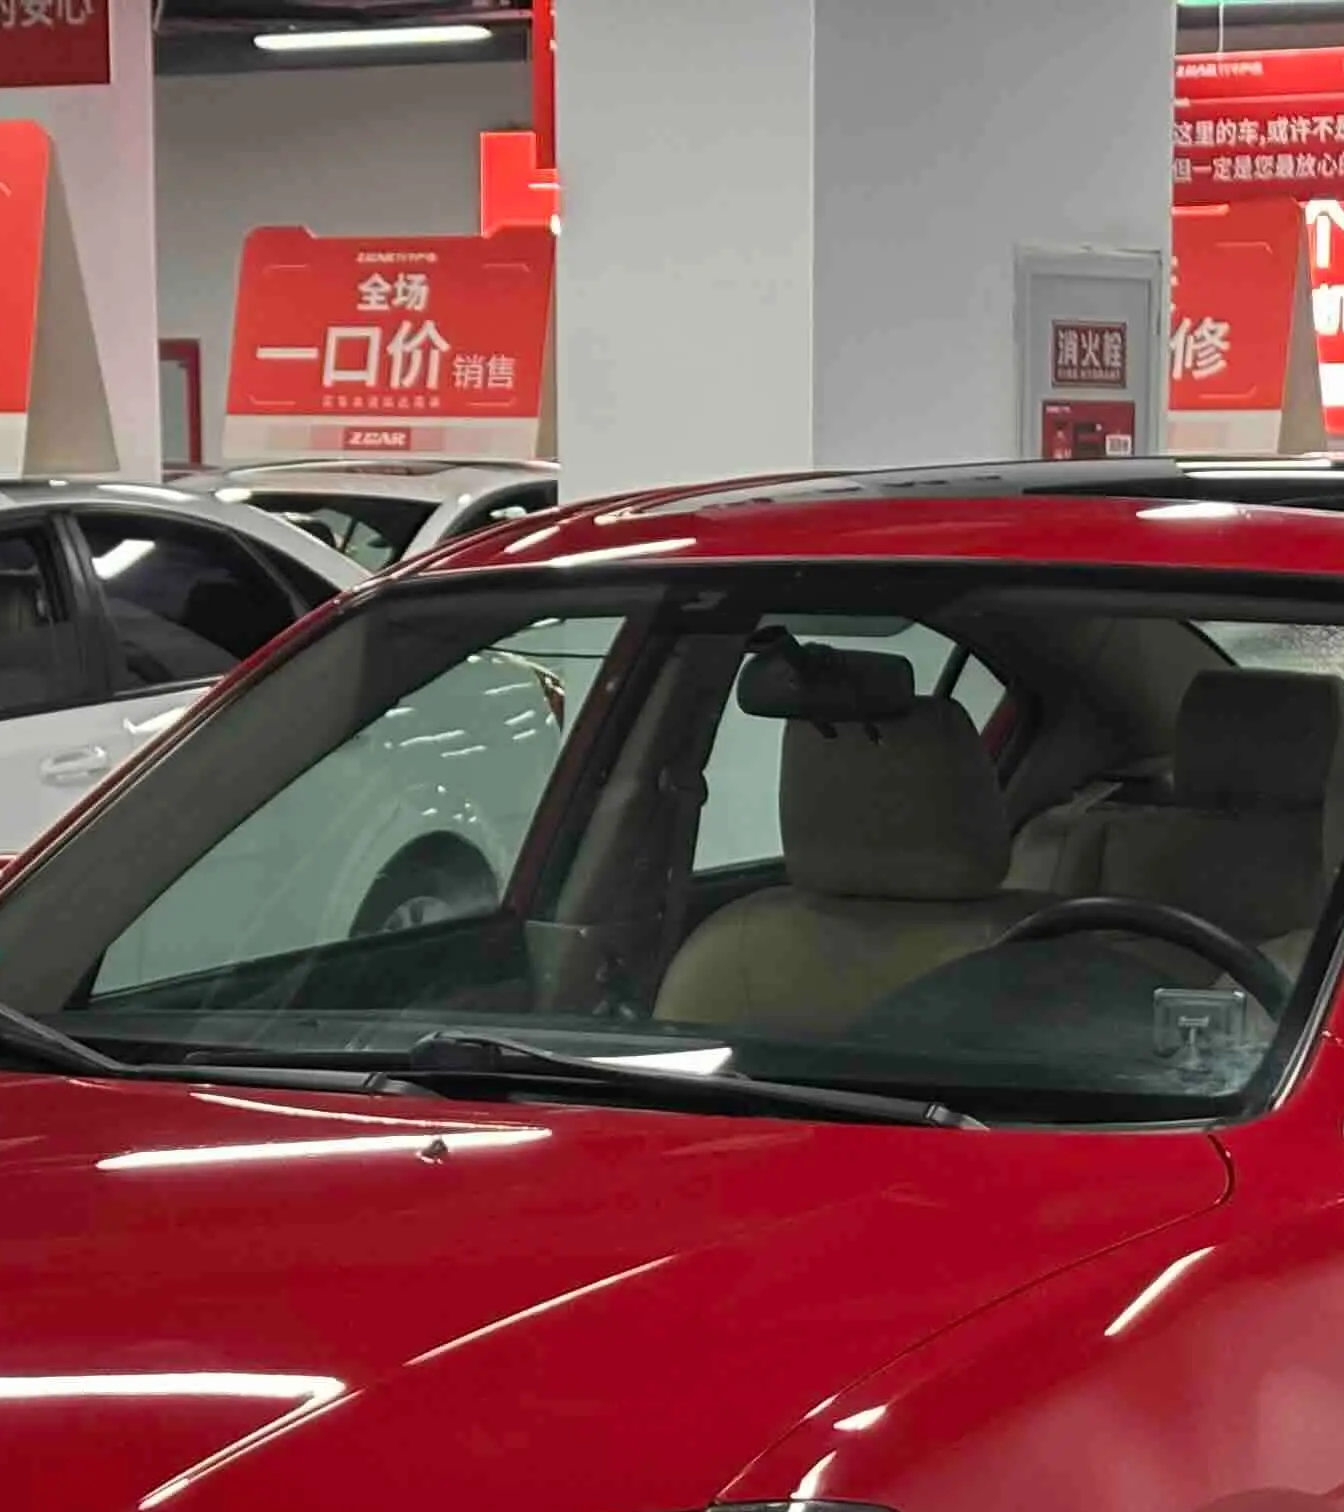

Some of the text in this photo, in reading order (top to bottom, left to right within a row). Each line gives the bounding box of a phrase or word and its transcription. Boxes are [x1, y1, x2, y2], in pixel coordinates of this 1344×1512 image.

[356, 271, 431, 313] 全场
[256, 320, 516, 390] 一口价 销售
[1057, 329, 1123, 368] 消火栓
